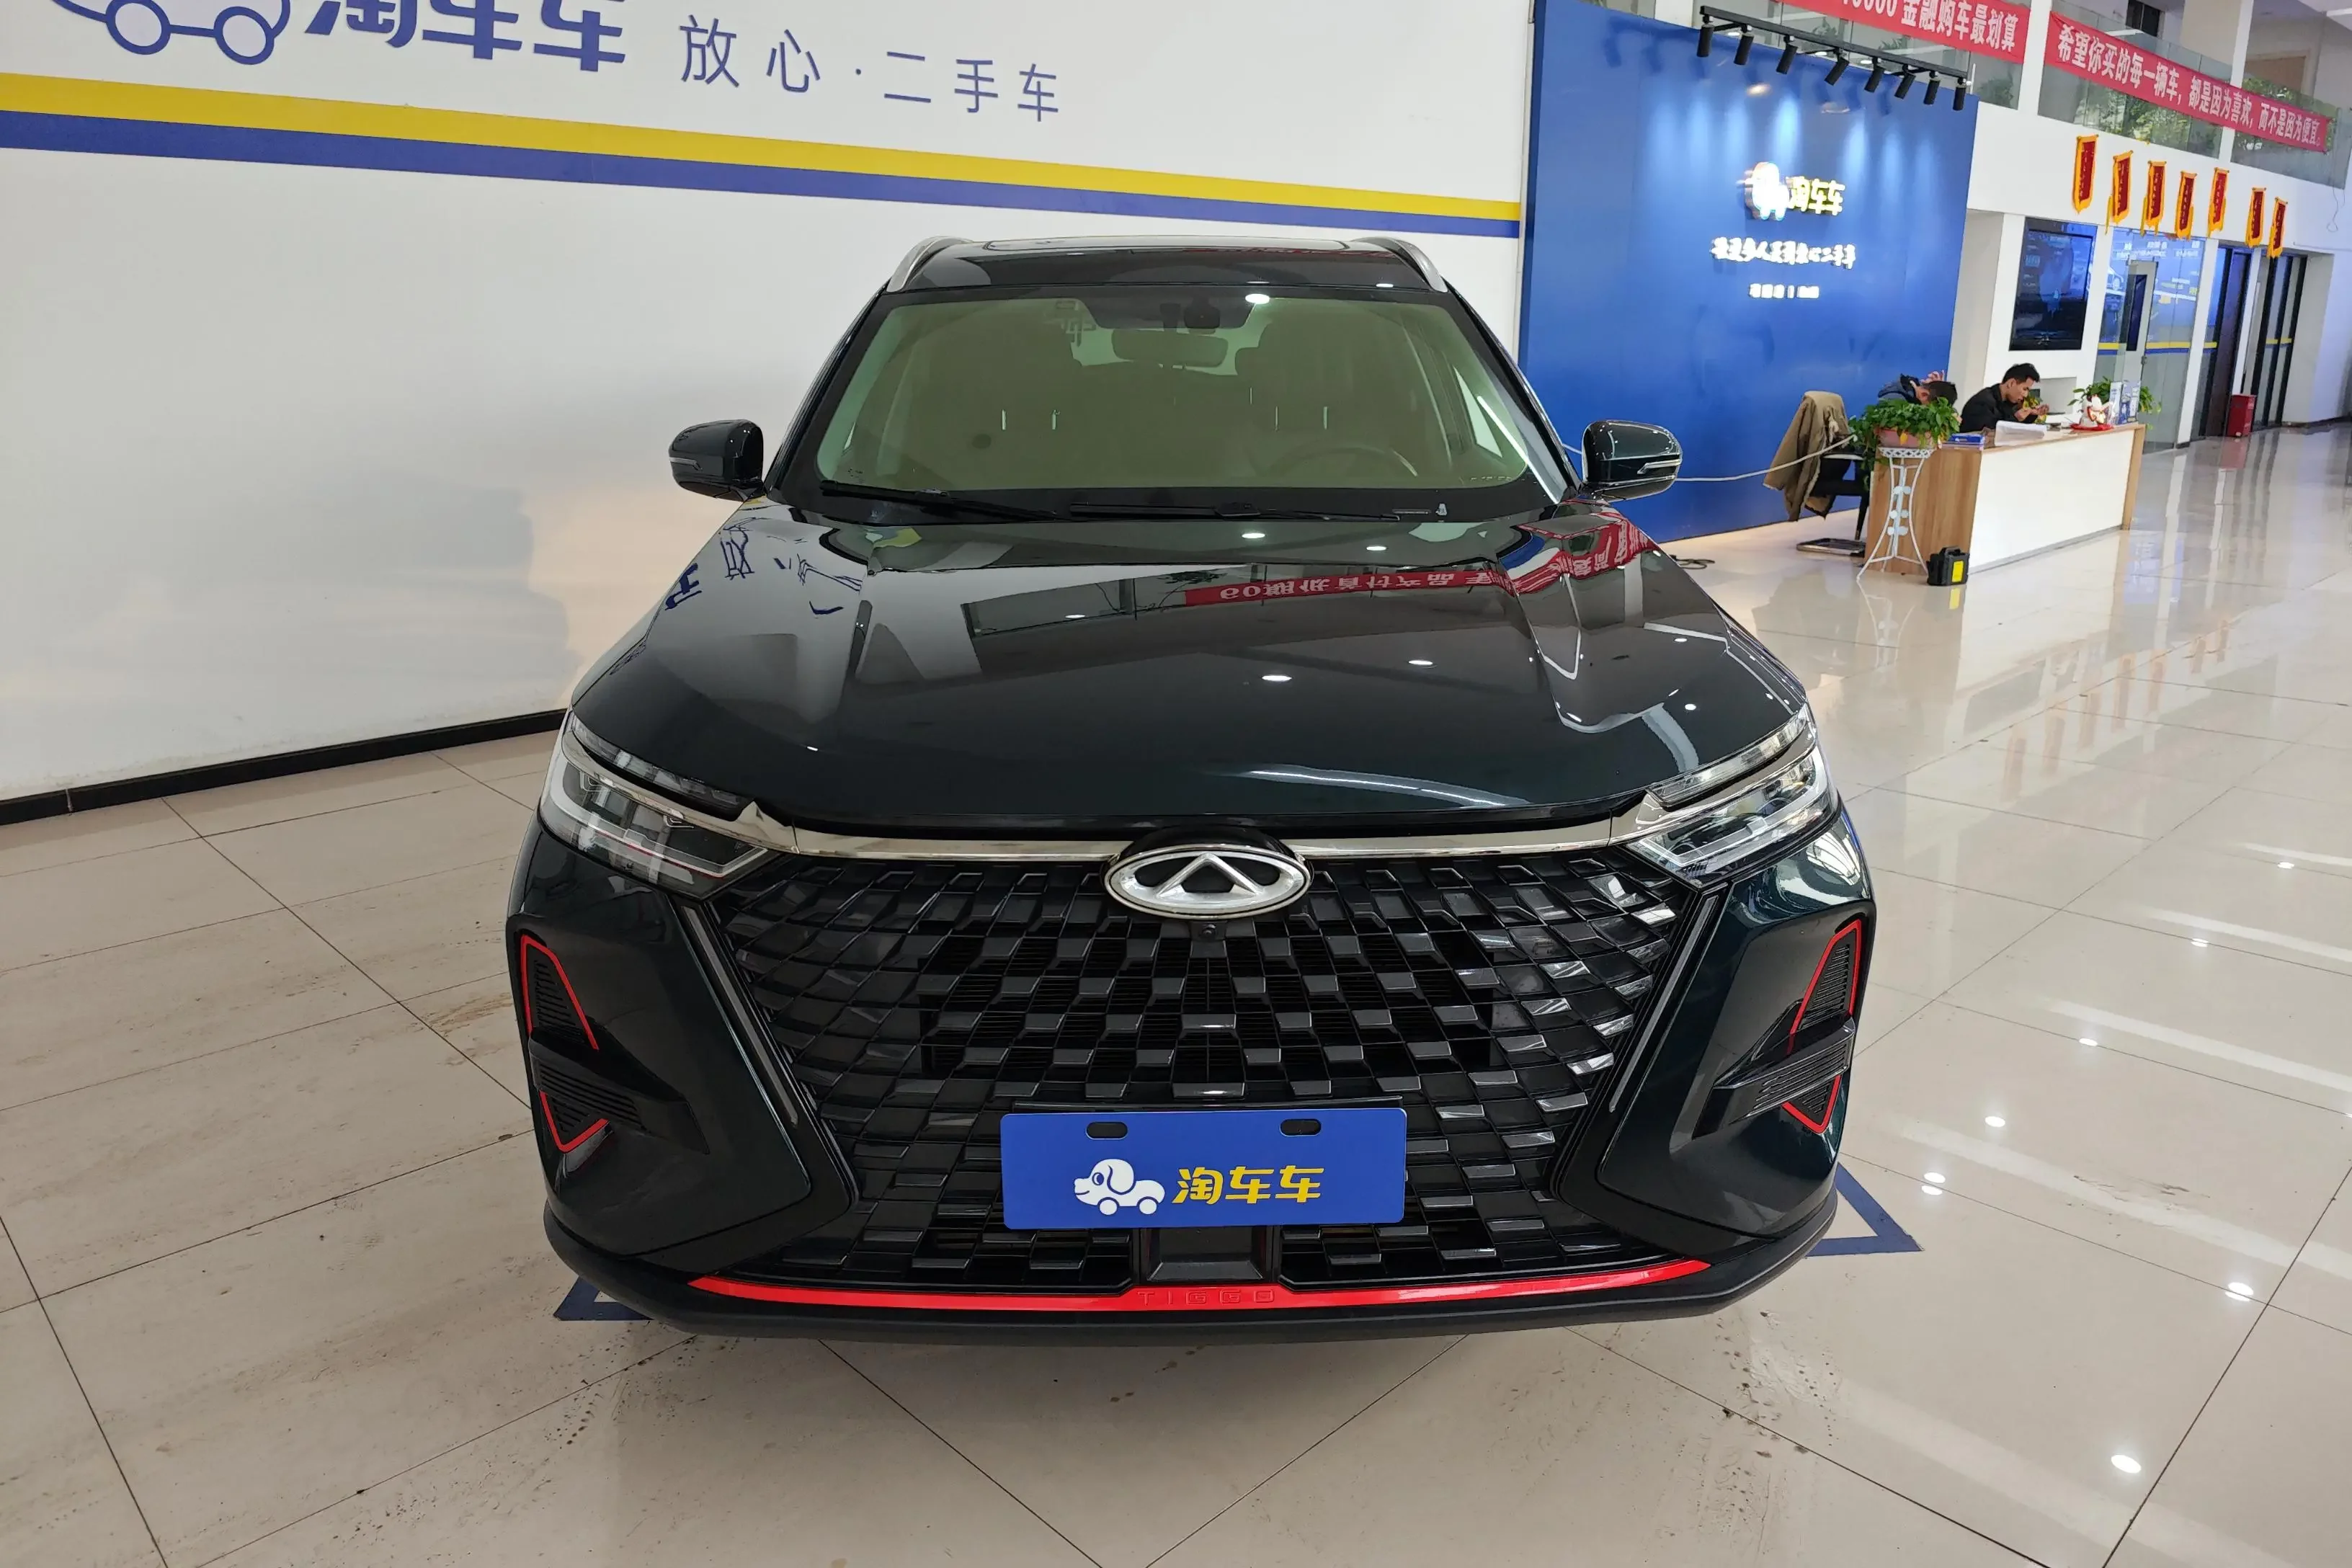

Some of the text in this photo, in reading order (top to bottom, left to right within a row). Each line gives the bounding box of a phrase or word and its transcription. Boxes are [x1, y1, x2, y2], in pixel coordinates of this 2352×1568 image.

[1172, 1164, 1324, 1205] 淘车车
[1138, 1289, 1275, 1306] TIGGO
